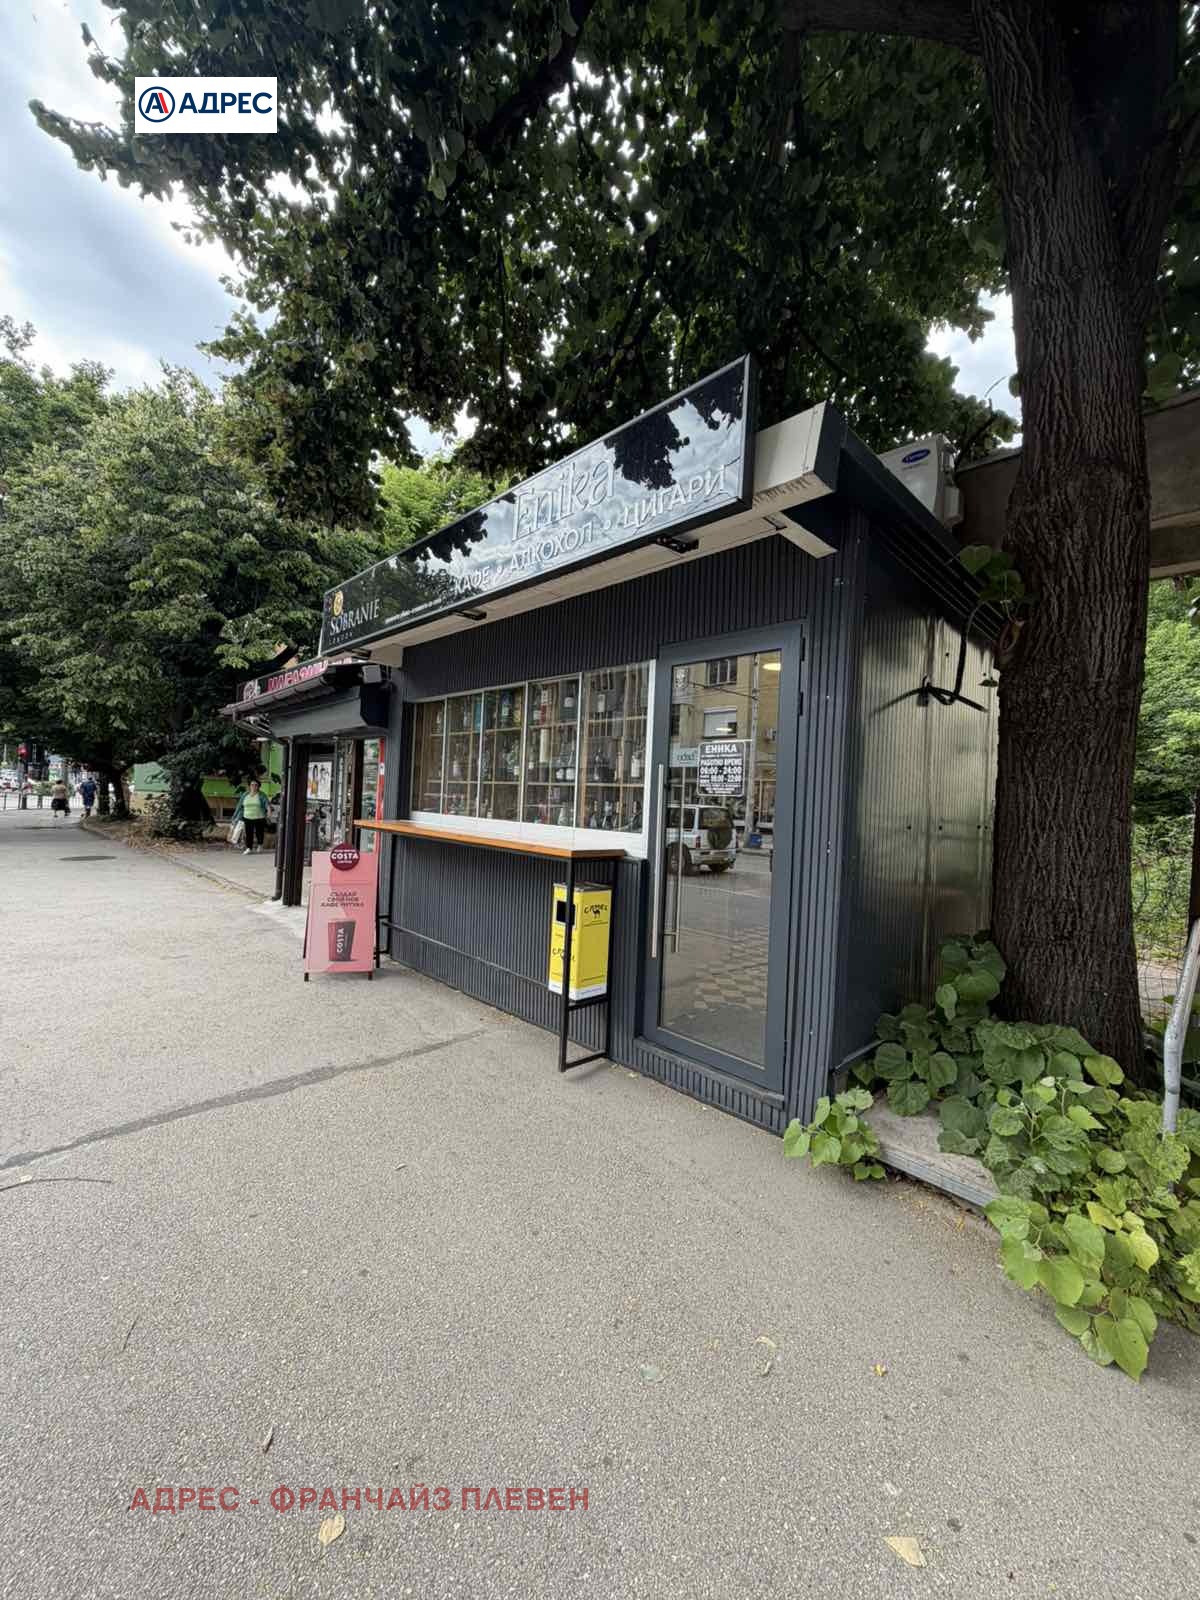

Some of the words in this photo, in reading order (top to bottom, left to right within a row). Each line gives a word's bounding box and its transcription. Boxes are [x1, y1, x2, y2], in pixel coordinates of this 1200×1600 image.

[512, 459, 616, 542] Enika
[455, 566, 490, 596] КАФЕ
[510, 522, 594, 574] АЛКОХОЛ
[623, 464, 728, 529] ЦИГАРИ
[329, 598, 380, 635] SOBRANIE
[331, 852, 359, 860] COSTA
[336, 928, 345, 953] COSTA
